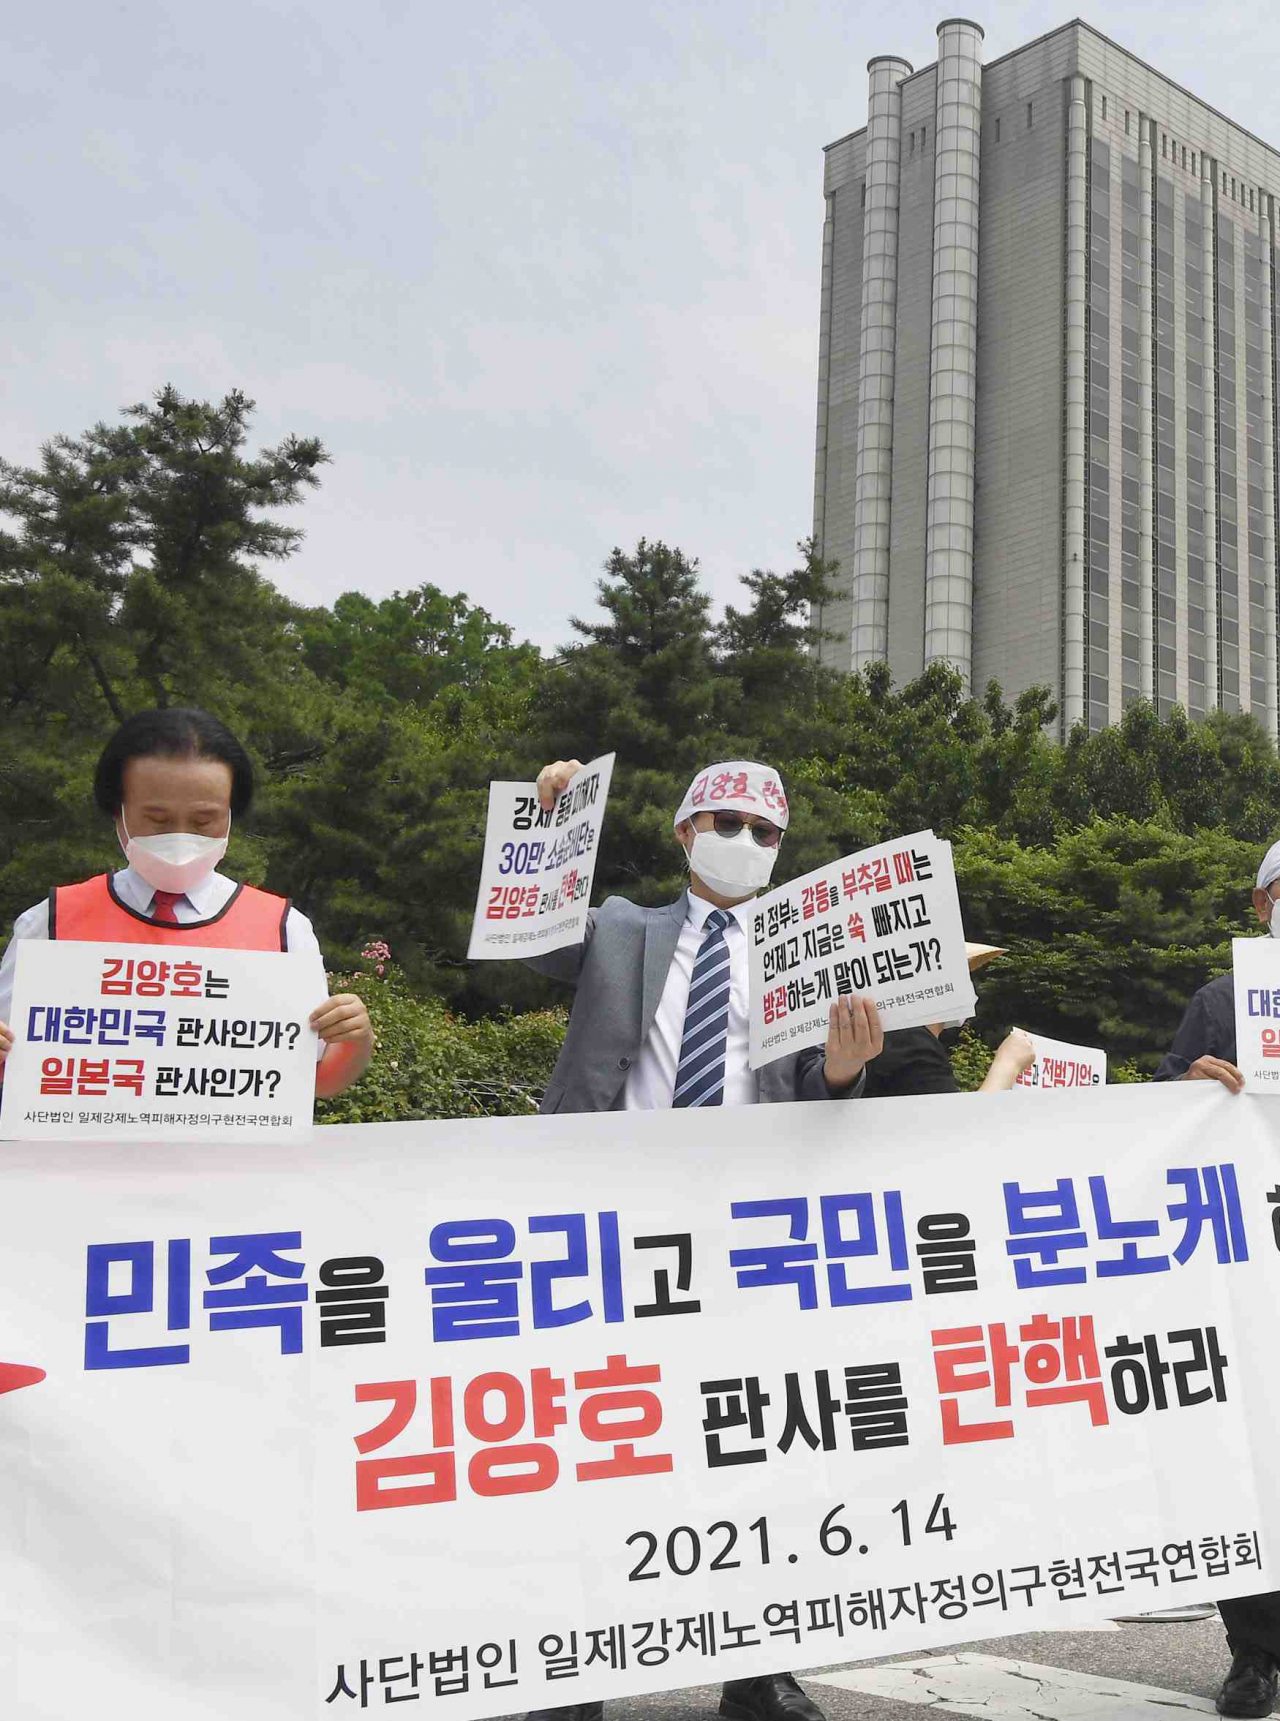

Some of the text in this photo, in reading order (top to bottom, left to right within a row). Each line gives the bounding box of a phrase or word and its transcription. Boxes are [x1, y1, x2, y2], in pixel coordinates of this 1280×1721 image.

[485, 884, 541, 920] 김양호
[499, 842, 545, 875] 30만
[753, 848, 933, 947] 현 정부는 갈등을 부추길 때는
[100, 958, 230, 999] 김양호는
[763, 935, 801, 982] 언제고
[803, 922, 845, 961] 지금은
[871, 893, 931, 937] 빠지고
[763, 937, 943, 1025] 방관하는게 말이 되는가?
[26, 1006, 301, 1051] 대한민국 판사인가?
[23, 1111, 293, 1127] 사단법인 일제강제노역피해자정의구현전국연합회
[39, 1057, 281, 1099] 일본국 판사인가?
[83, 1230, 390, 1371] 민족을
[424, 1210, 702, 1343] 울리고
[728, 1190, 979, 1311] 국민을
[1002, 1163, 1250, 1290] 분노케
[353, 1313, 1229, 1513] 김양호 판사를 탄핵하라
[625, 1493, 957, 1582] 2021. 6. 14
[324, 1530, 1264, 1709] 사단법인 일제강제노역피해자정의구현전국연합회
